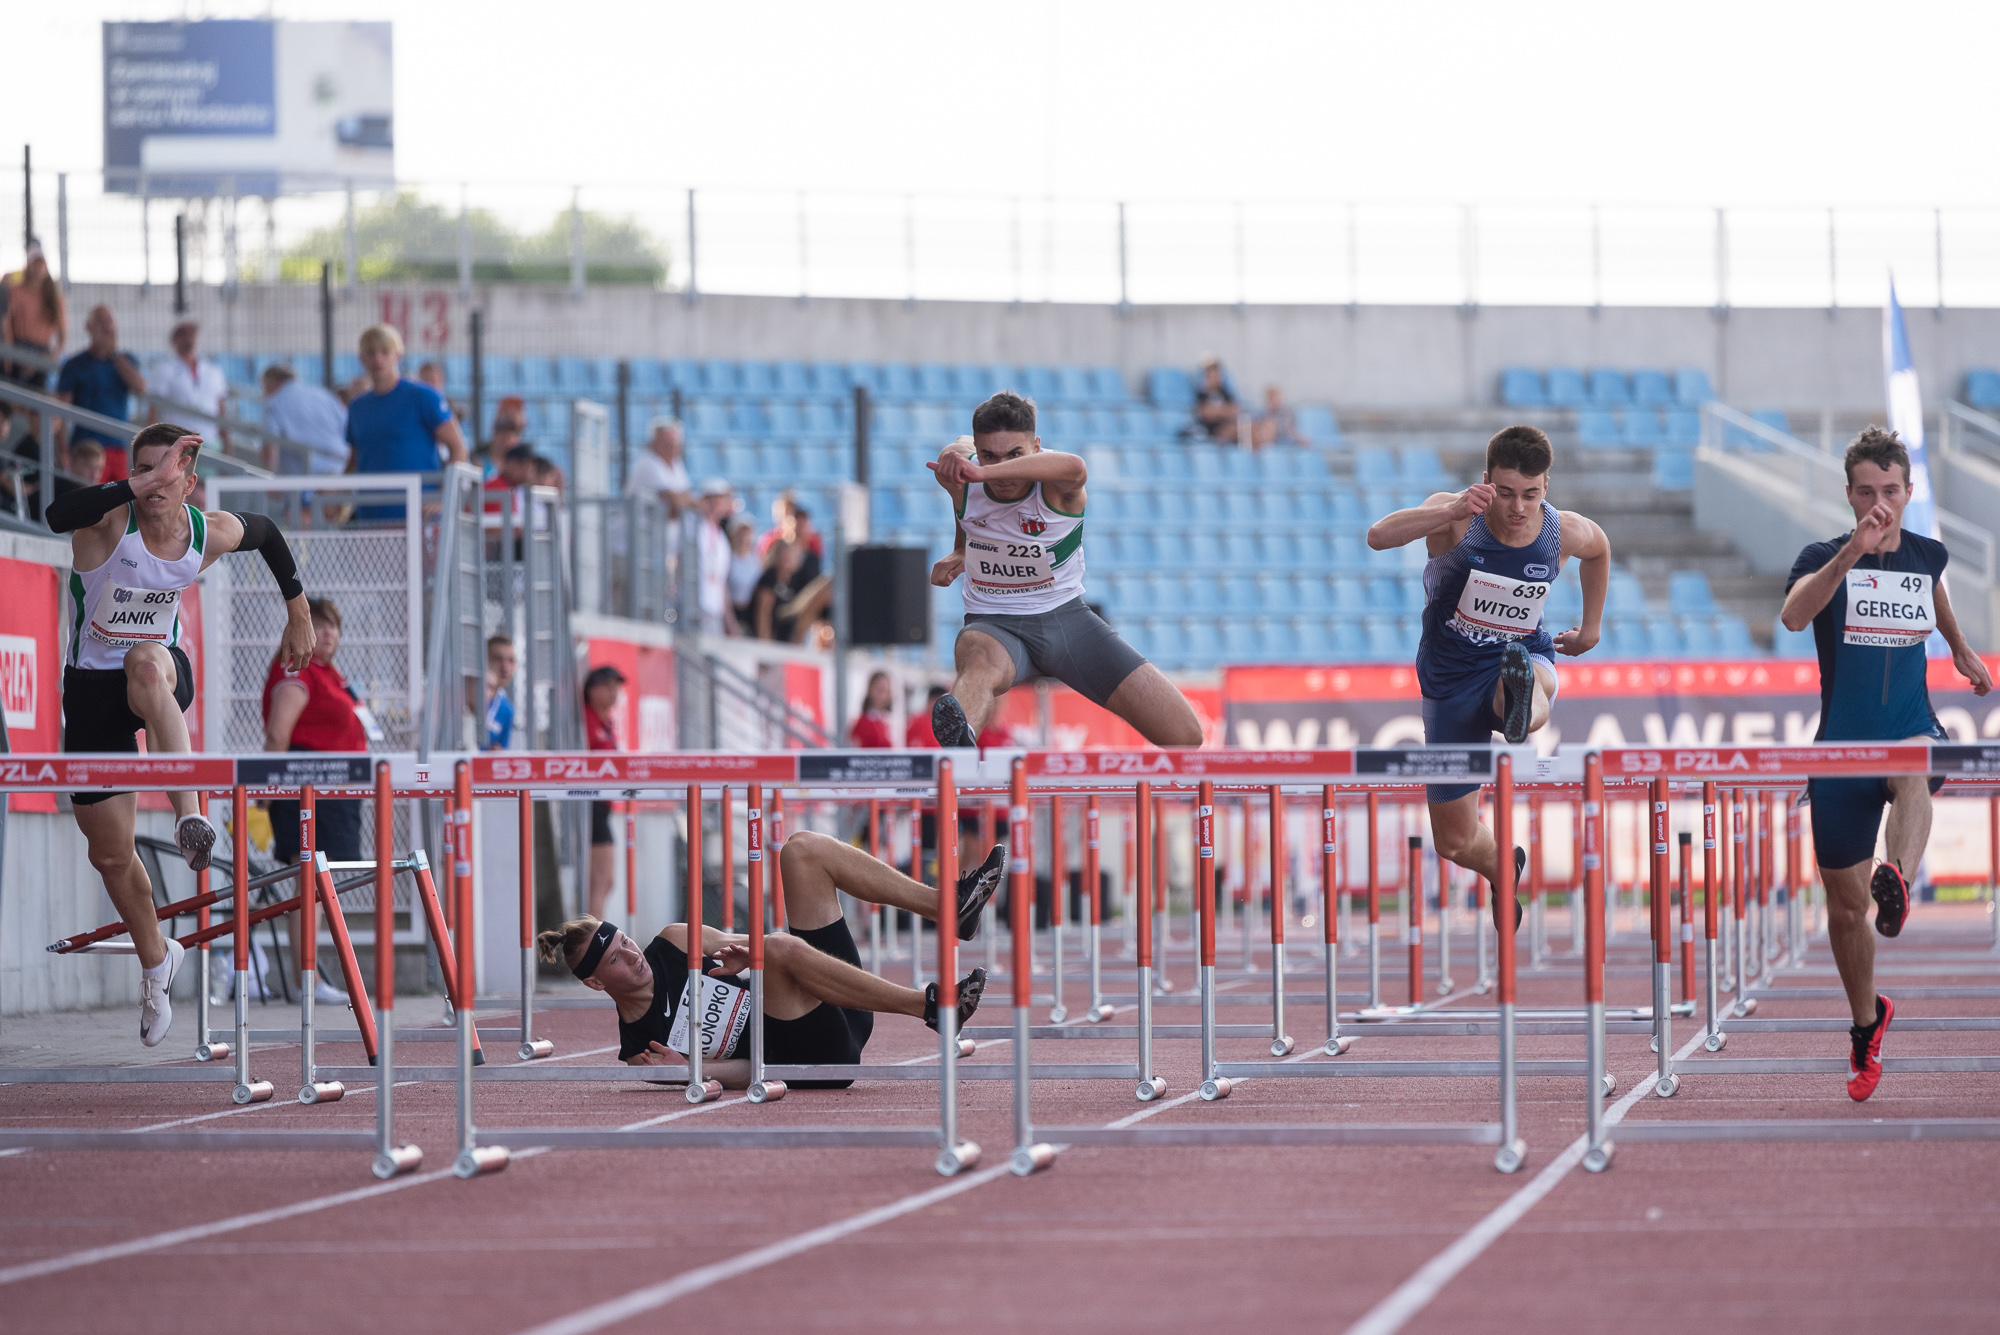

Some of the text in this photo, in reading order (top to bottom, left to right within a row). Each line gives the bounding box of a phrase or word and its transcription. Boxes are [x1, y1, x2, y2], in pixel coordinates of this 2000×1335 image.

[1006, 544, 1042, 559] 223
[979, 560, 1039, 578] BAUER
[1512, 584, 1547, 600] 639
[1900, 576, 1922, 593] 49
[143, 591, 176, 604] 803
[1473, 597, 1531, 620] WITOS
[1855, 599, 1928, 621] GEREGA
[107, 611, 158, 625] JANIK
[92, 629, 140, 647] WŁOCŁAWE
[1850, 634, 1908, 646] WŁOCŁAWEK
[544, 759, 619, 779] PZLA
[1100, 754, 1175, 773] PZLA
[1674, 751, 1749, 771] PZLA
[0, 762, 57, 782] ZLA
[751, 822, 759, 848] polanik
[1657, 814, 1665, 841] polanik
